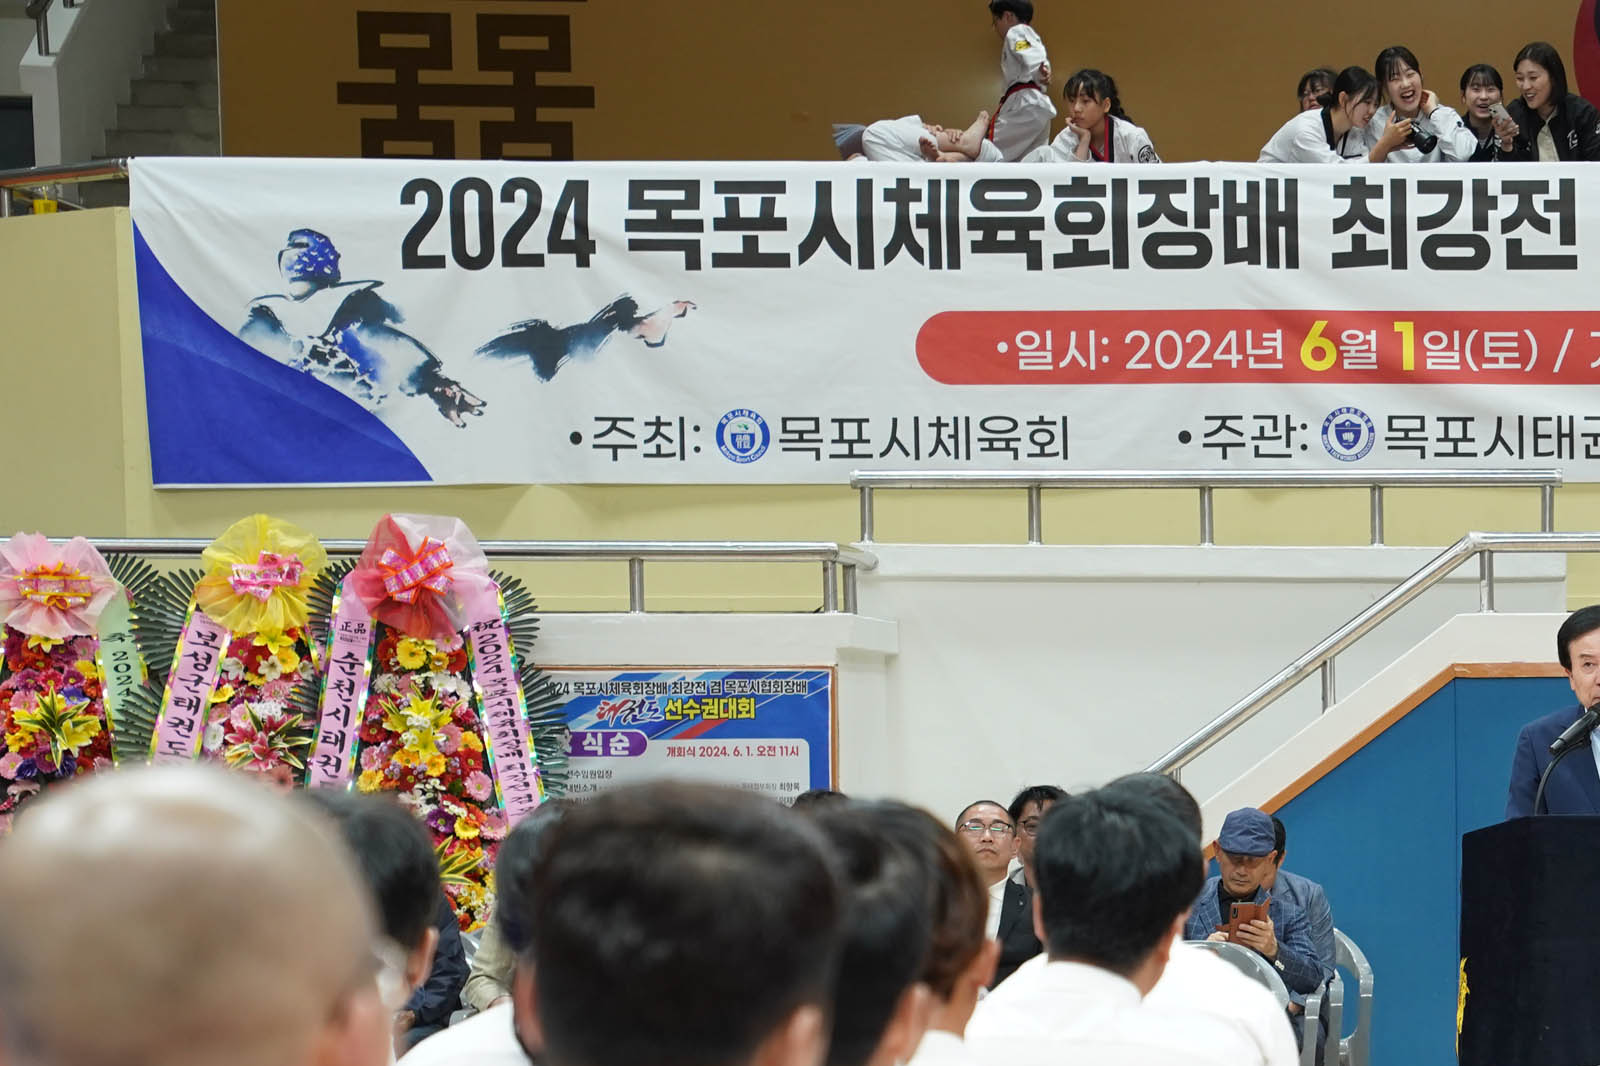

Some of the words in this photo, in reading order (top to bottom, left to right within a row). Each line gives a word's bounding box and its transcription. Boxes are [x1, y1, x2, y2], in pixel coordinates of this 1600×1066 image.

[400, 177, 596, 271] 2024
[624, 176, 1299, 271] 목포시체육회장배
[1331, 176, 1578, 271] 최강전
[1124, 329, 1284, 370] 2024년
[1300, 320, 1378, 371] 6월
[1394, 321, 1538, 372] 1일(토)
[778, 415, 1069, 462] 목포시체육회
[112, 650, 133, 697] 2024
[477, 633, 505, 674] 2024
[573, 681, 668, 696] 목포시체육회장배
[671, 680, 706, 695] 최강전
[710, 680, 721, 694] 겸
[725, 679, 807, 695] 목포시협회장배
[665, 697, 756, 721] 선수권대회
[666, 746, 697, 758] 개회식
[699, 745, 730, 758] 2024.
[732, 745, 743, 758] 6.
[757, 745, 777, 758] 오전
[780, 745, 800, 758] 11시
